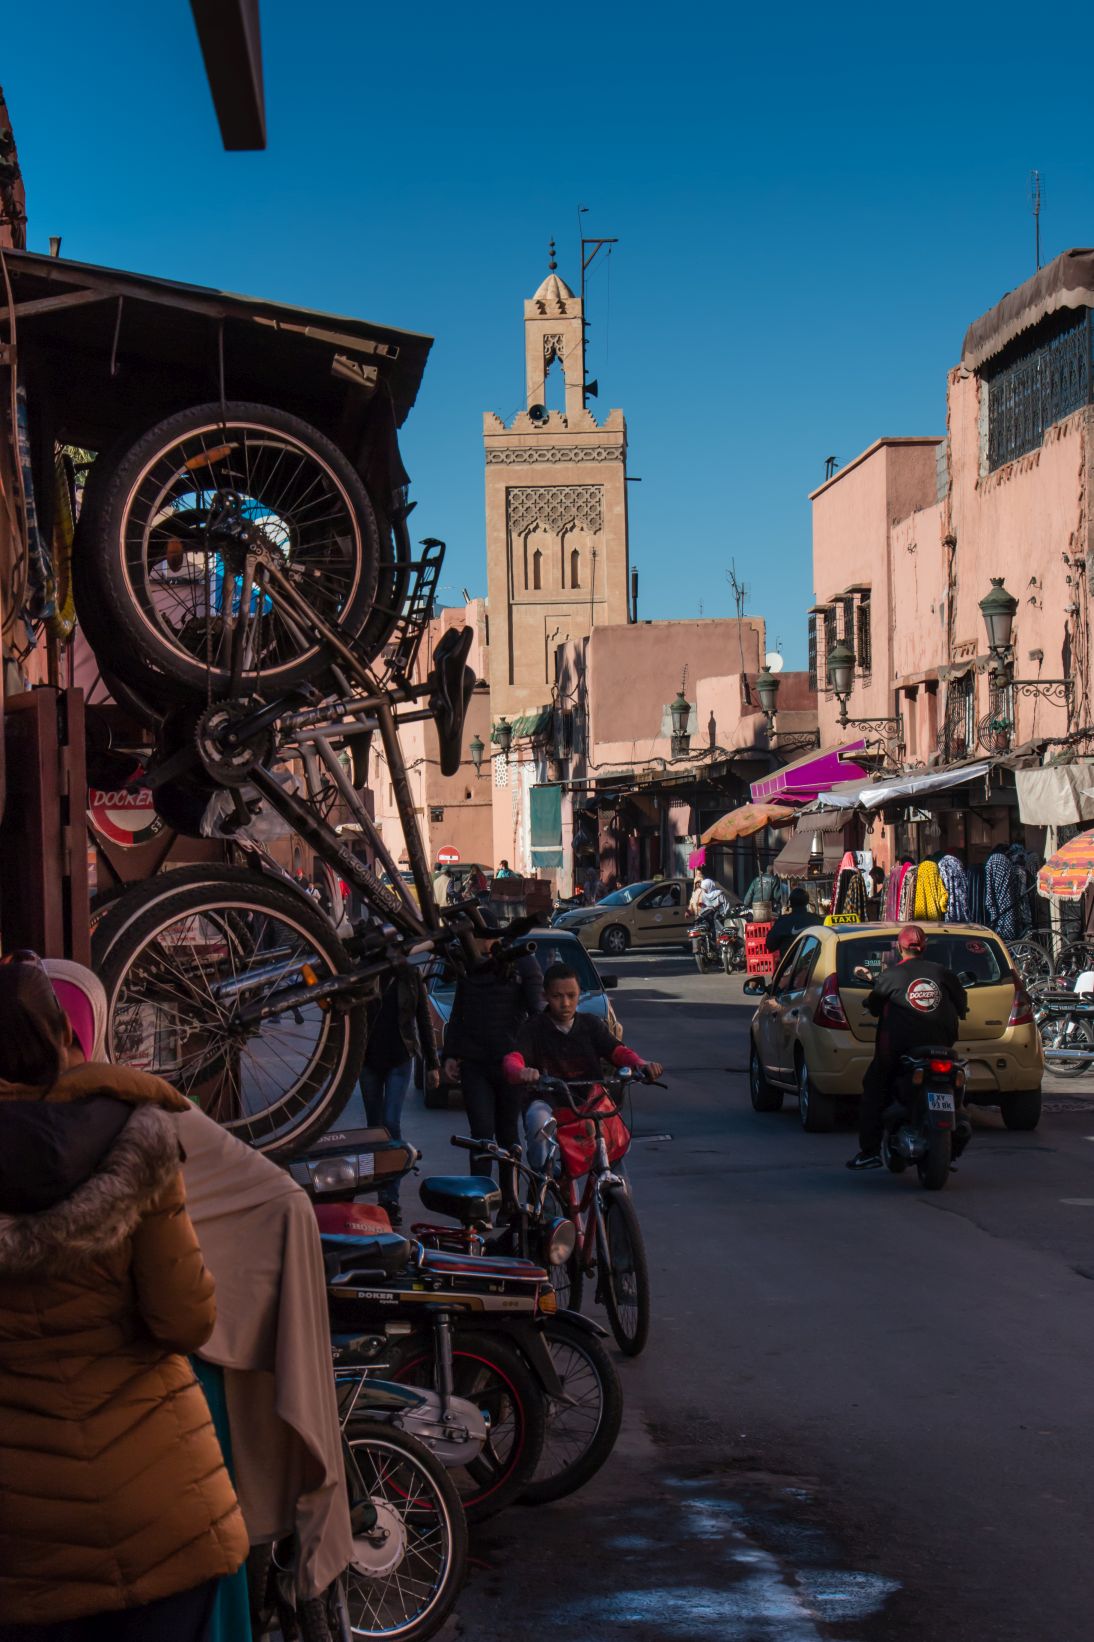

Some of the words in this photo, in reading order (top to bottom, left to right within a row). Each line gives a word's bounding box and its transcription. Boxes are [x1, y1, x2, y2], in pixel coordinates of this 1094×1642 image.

[832, 915, 856, 923] TAXI
[317, 1134, 347, 1144] ONDA
[358, 1291, 394, 1300] DOKER
